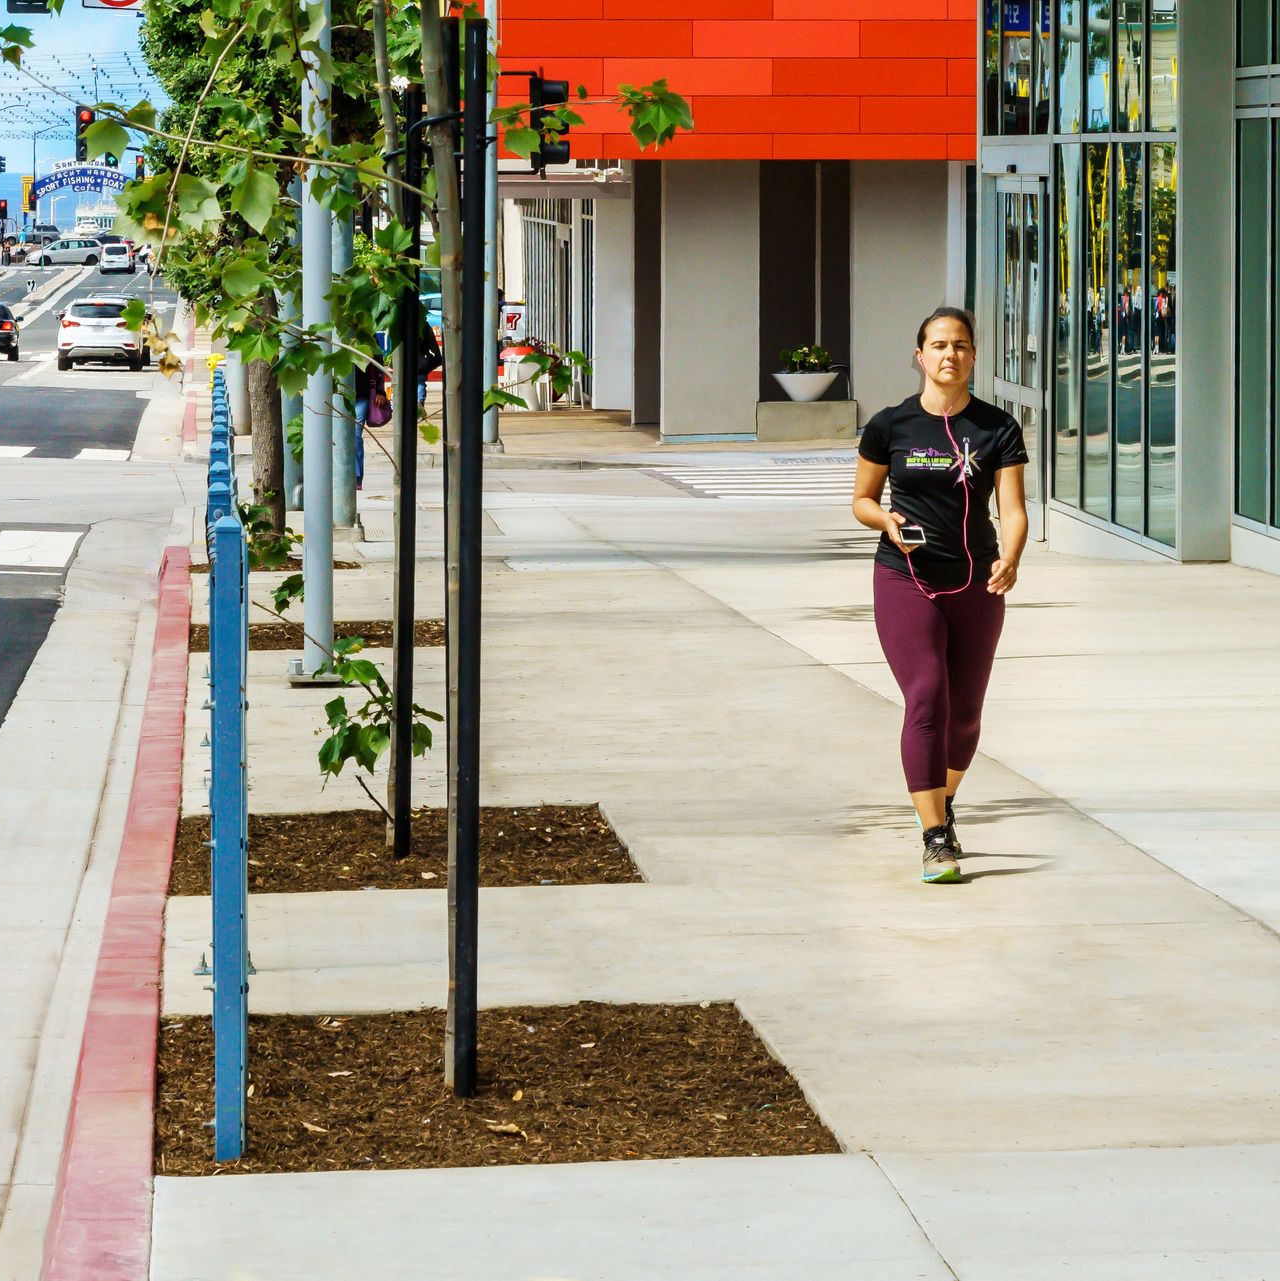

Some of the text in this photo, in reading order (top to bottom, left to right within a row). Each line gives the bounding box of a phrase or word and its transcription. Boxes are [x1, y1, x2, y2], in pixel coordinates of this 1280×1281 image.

[55, 160, 83, 170] SANTA
[50, 169, 124, 181] YACHT HARBOR
[36, 176, 124, 197] SPORT FISHING BOAT
